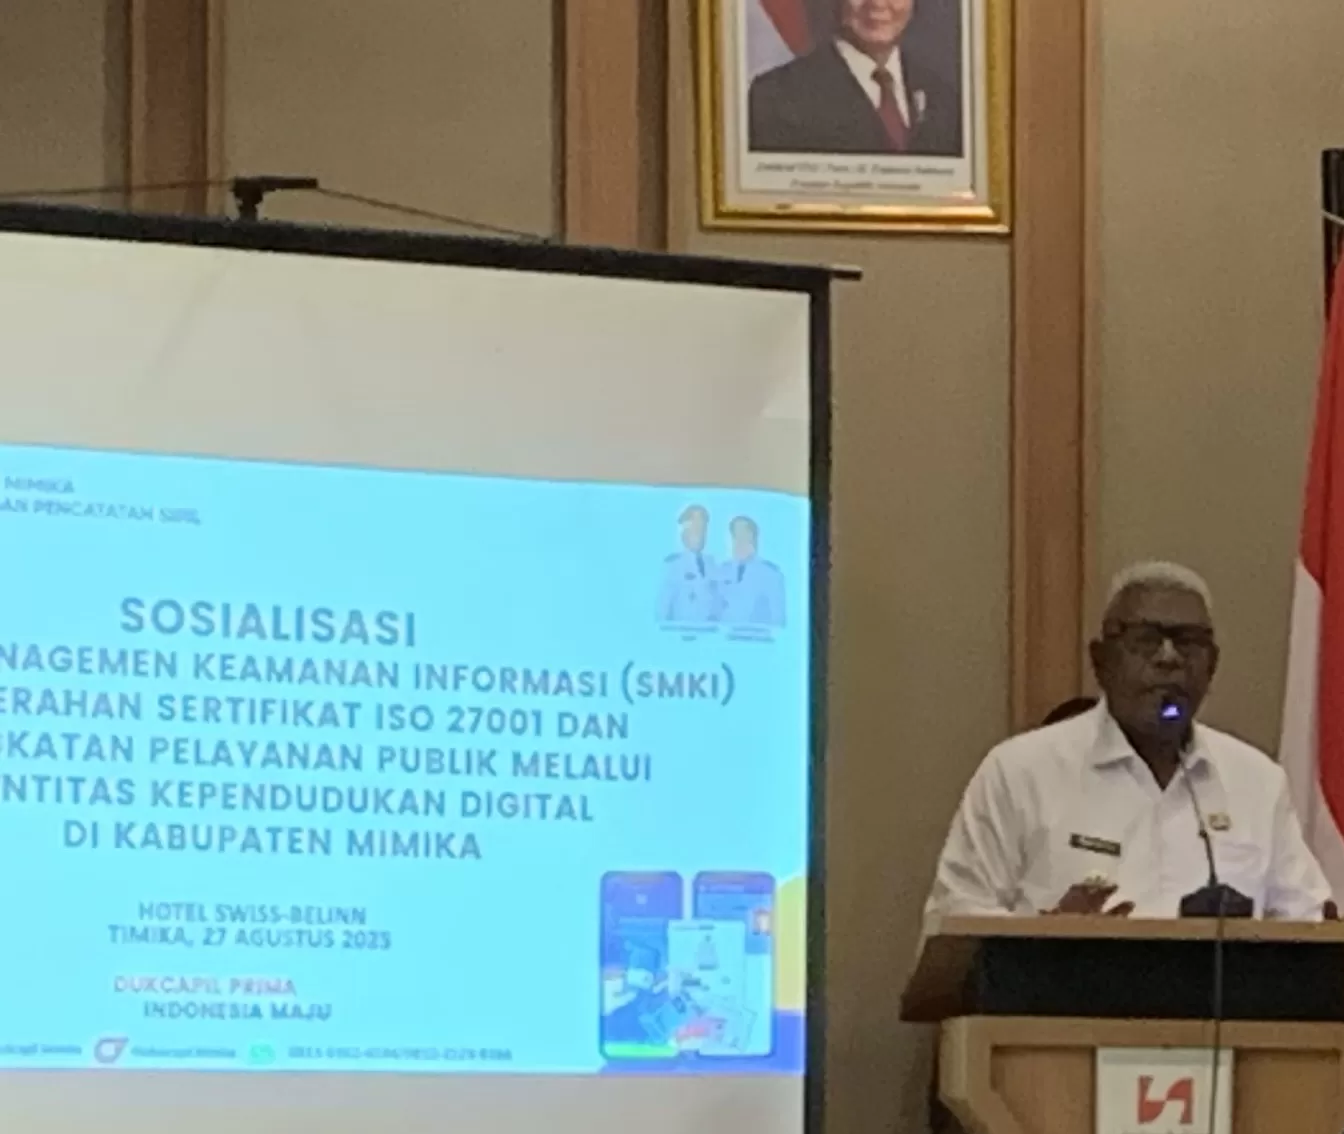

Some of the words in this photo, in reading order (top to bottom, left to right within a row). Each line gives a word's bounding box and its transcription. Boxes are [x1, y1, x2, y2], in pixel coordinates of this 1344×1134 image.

[119, 596, 416, 648] SOSIALISASI
[193, 652, 400, 691] KEAMANAN
[414, 661, 608, 698] INFORMASI
[621, 659, 736, 707] (SMKI)
[157, 692, 362, 729] SERTIFIKAT
[376, 702, 434, 733] ISO
[446, 705, 544, 737] 27001
[556, 711, 630, 740] DAN
[0, 730, 135, 763] KATAN
[149, 735, 364, 771] PELAYANAN
[377, 745, 498, 778] PUBLIK
[511, 750, 652, 783] MELALUI
[2, 773, 136, 806] NTITAS
[150, 779, 447, 819] KEPENDUDUKAN
[460, 789, 595, 822] DIGITAL
[63, 819, 99, 849] DI
[114, 820, 332, 856] KABUPATEN
[346, 827, 483, 860] MIMIKA
[138, 902, 212, 923] HOTEL
[215, 902, 367, 926] SWISS-BELINN
[202, 925, 228, 947] 27
[234, 926, 335, 949] AGUSTUS
[229, 976, 297, 997] PRIMA
[143, 999, 264, 1021] INDONESIA
[270, 1001, 333, 1022] MAJU
